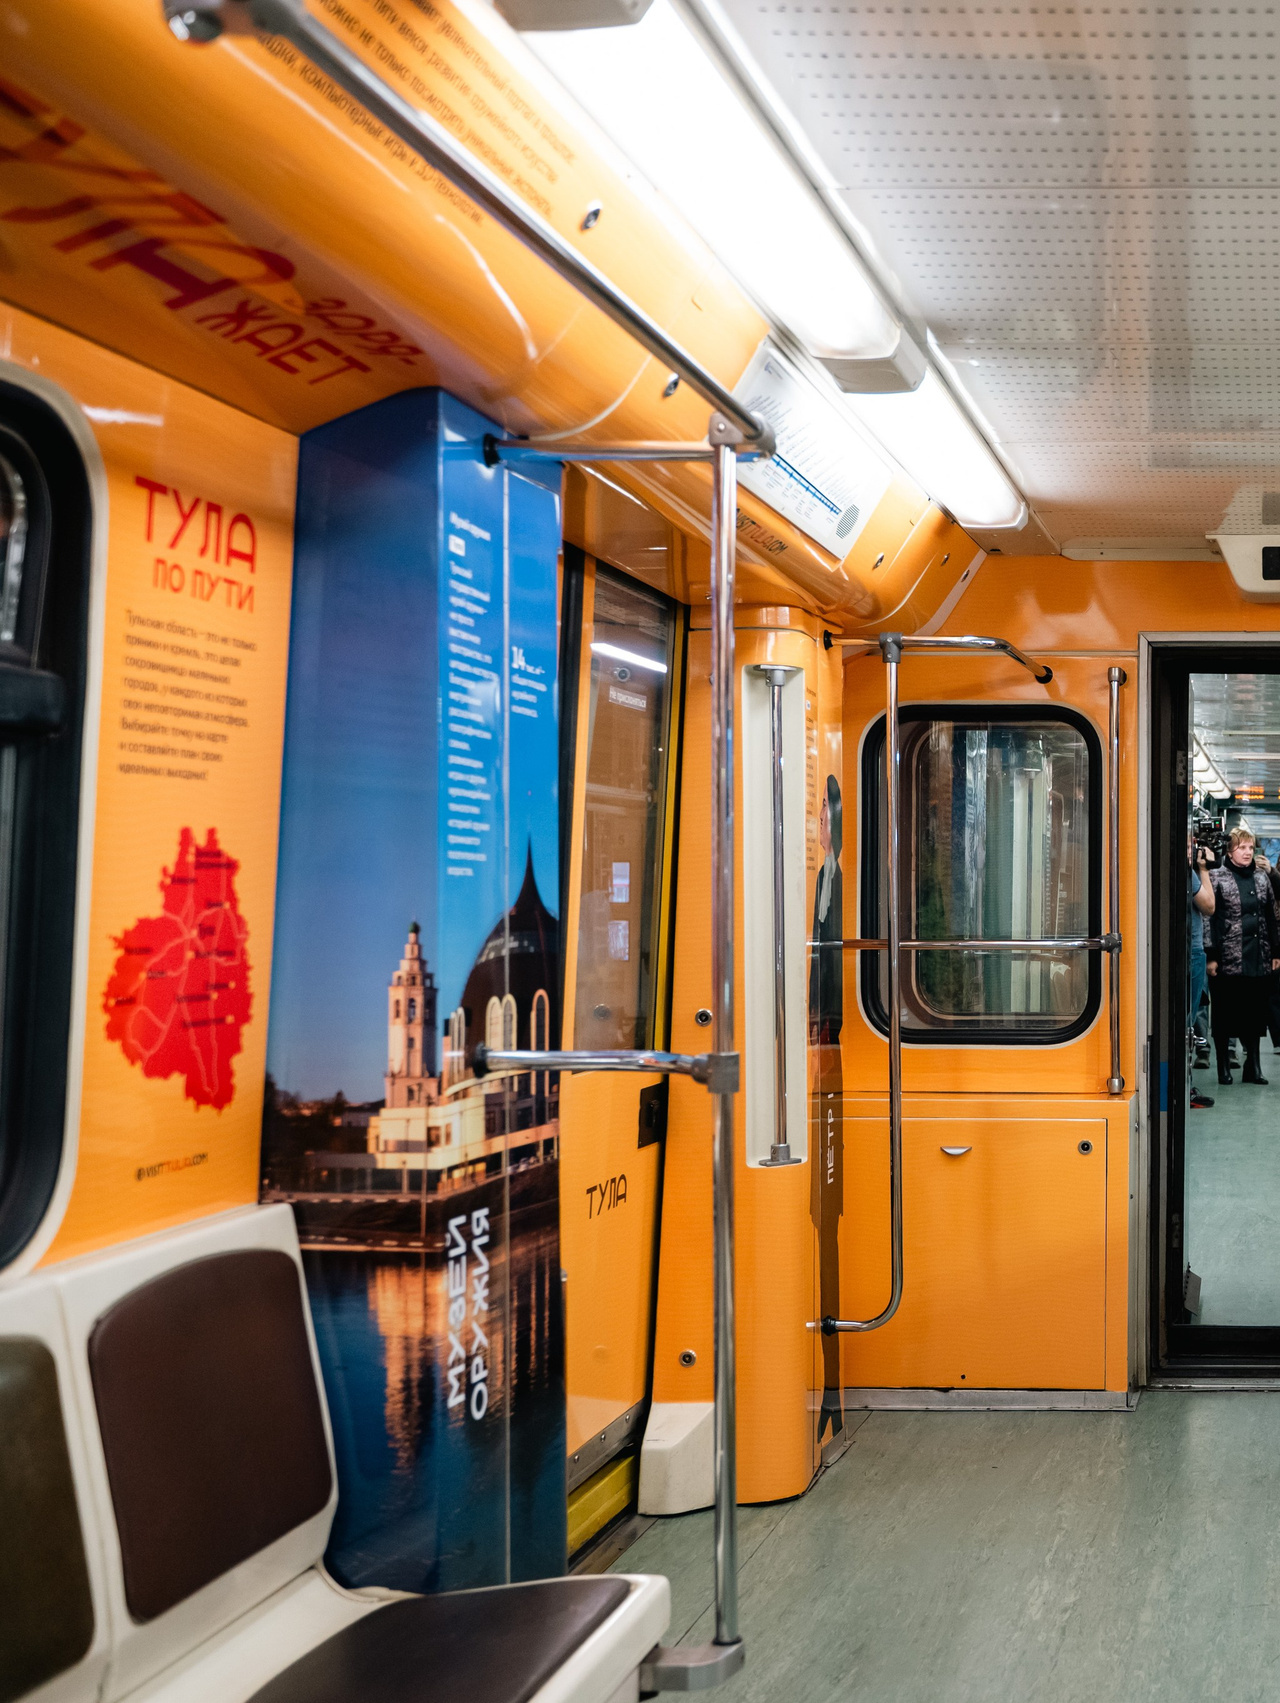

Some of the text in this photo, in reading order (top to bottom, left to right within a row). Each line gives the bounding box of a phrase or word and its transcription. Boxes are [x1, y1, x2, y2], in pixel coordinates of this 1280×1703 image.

[0, 78, 297, 310] УЛА
[195, 299, 372, 387] ЖАЕТ
[135, 475, 256, 575] ТУЛА
[153, 557, 255, 614] ПО ПУТИ
[586, 1173, 627, 1220] ТУЛА
[446, 1214, 467, 1409] МУЗЕЙ
[471, 1206, 490, 1421] ОРУЖИЯ
